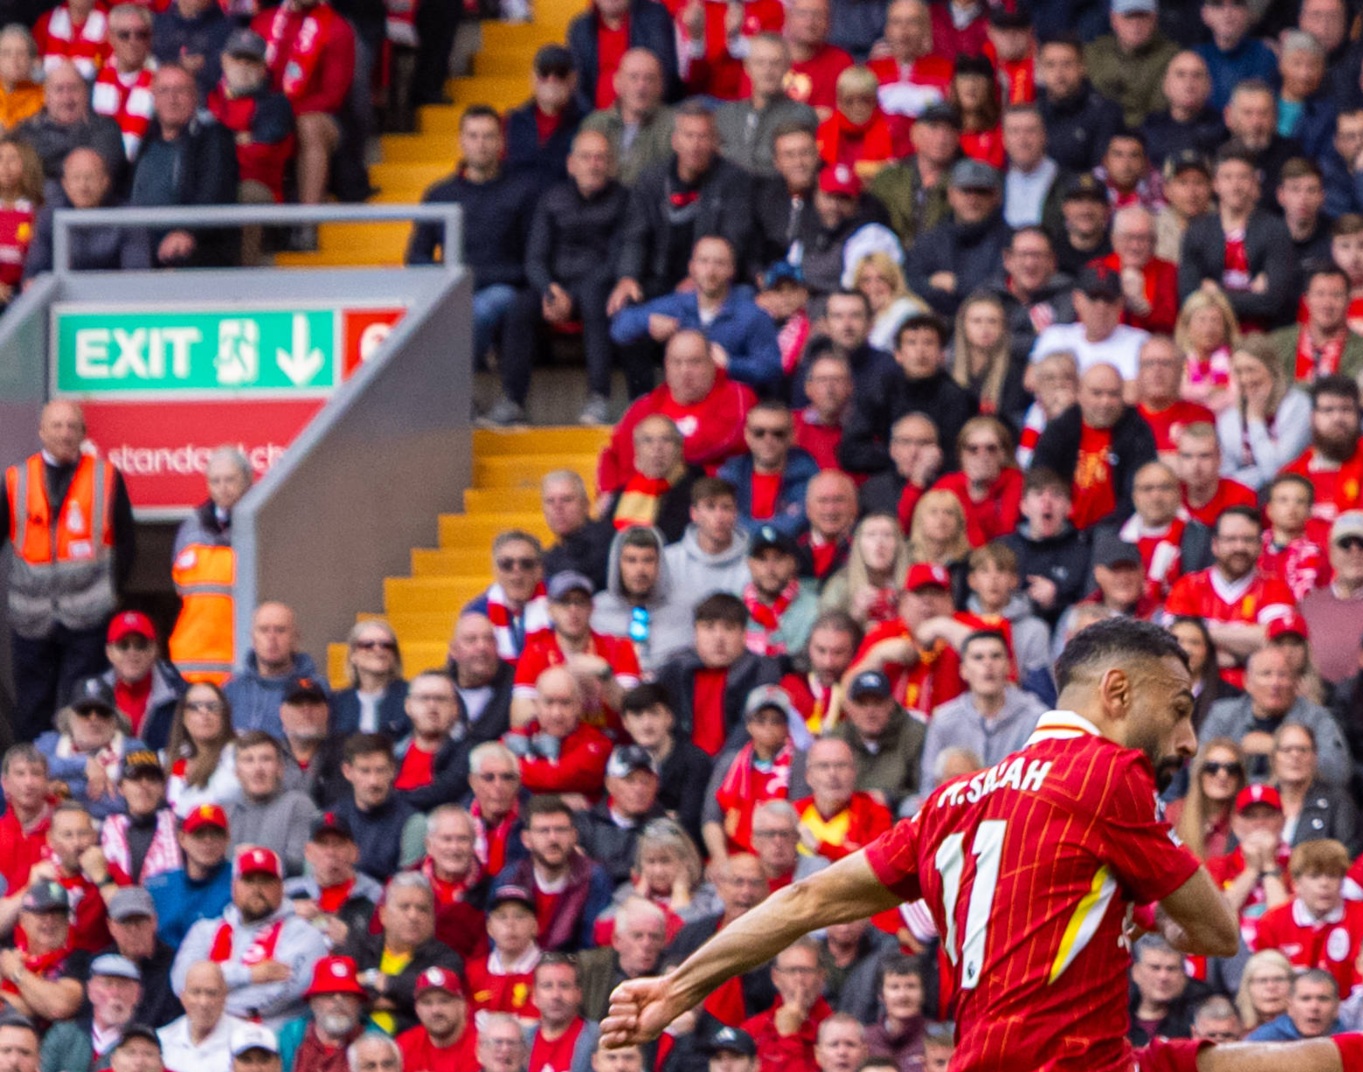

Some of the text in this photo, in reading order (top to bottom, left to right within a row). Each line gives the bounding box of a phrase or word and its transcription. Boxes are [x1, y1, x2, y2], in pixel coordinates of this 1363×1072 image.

[75, 326, 202, 378] EXIT
[937, 756, 1053, 808] M.SAAH
[934, 819, 1008, 989] 11
